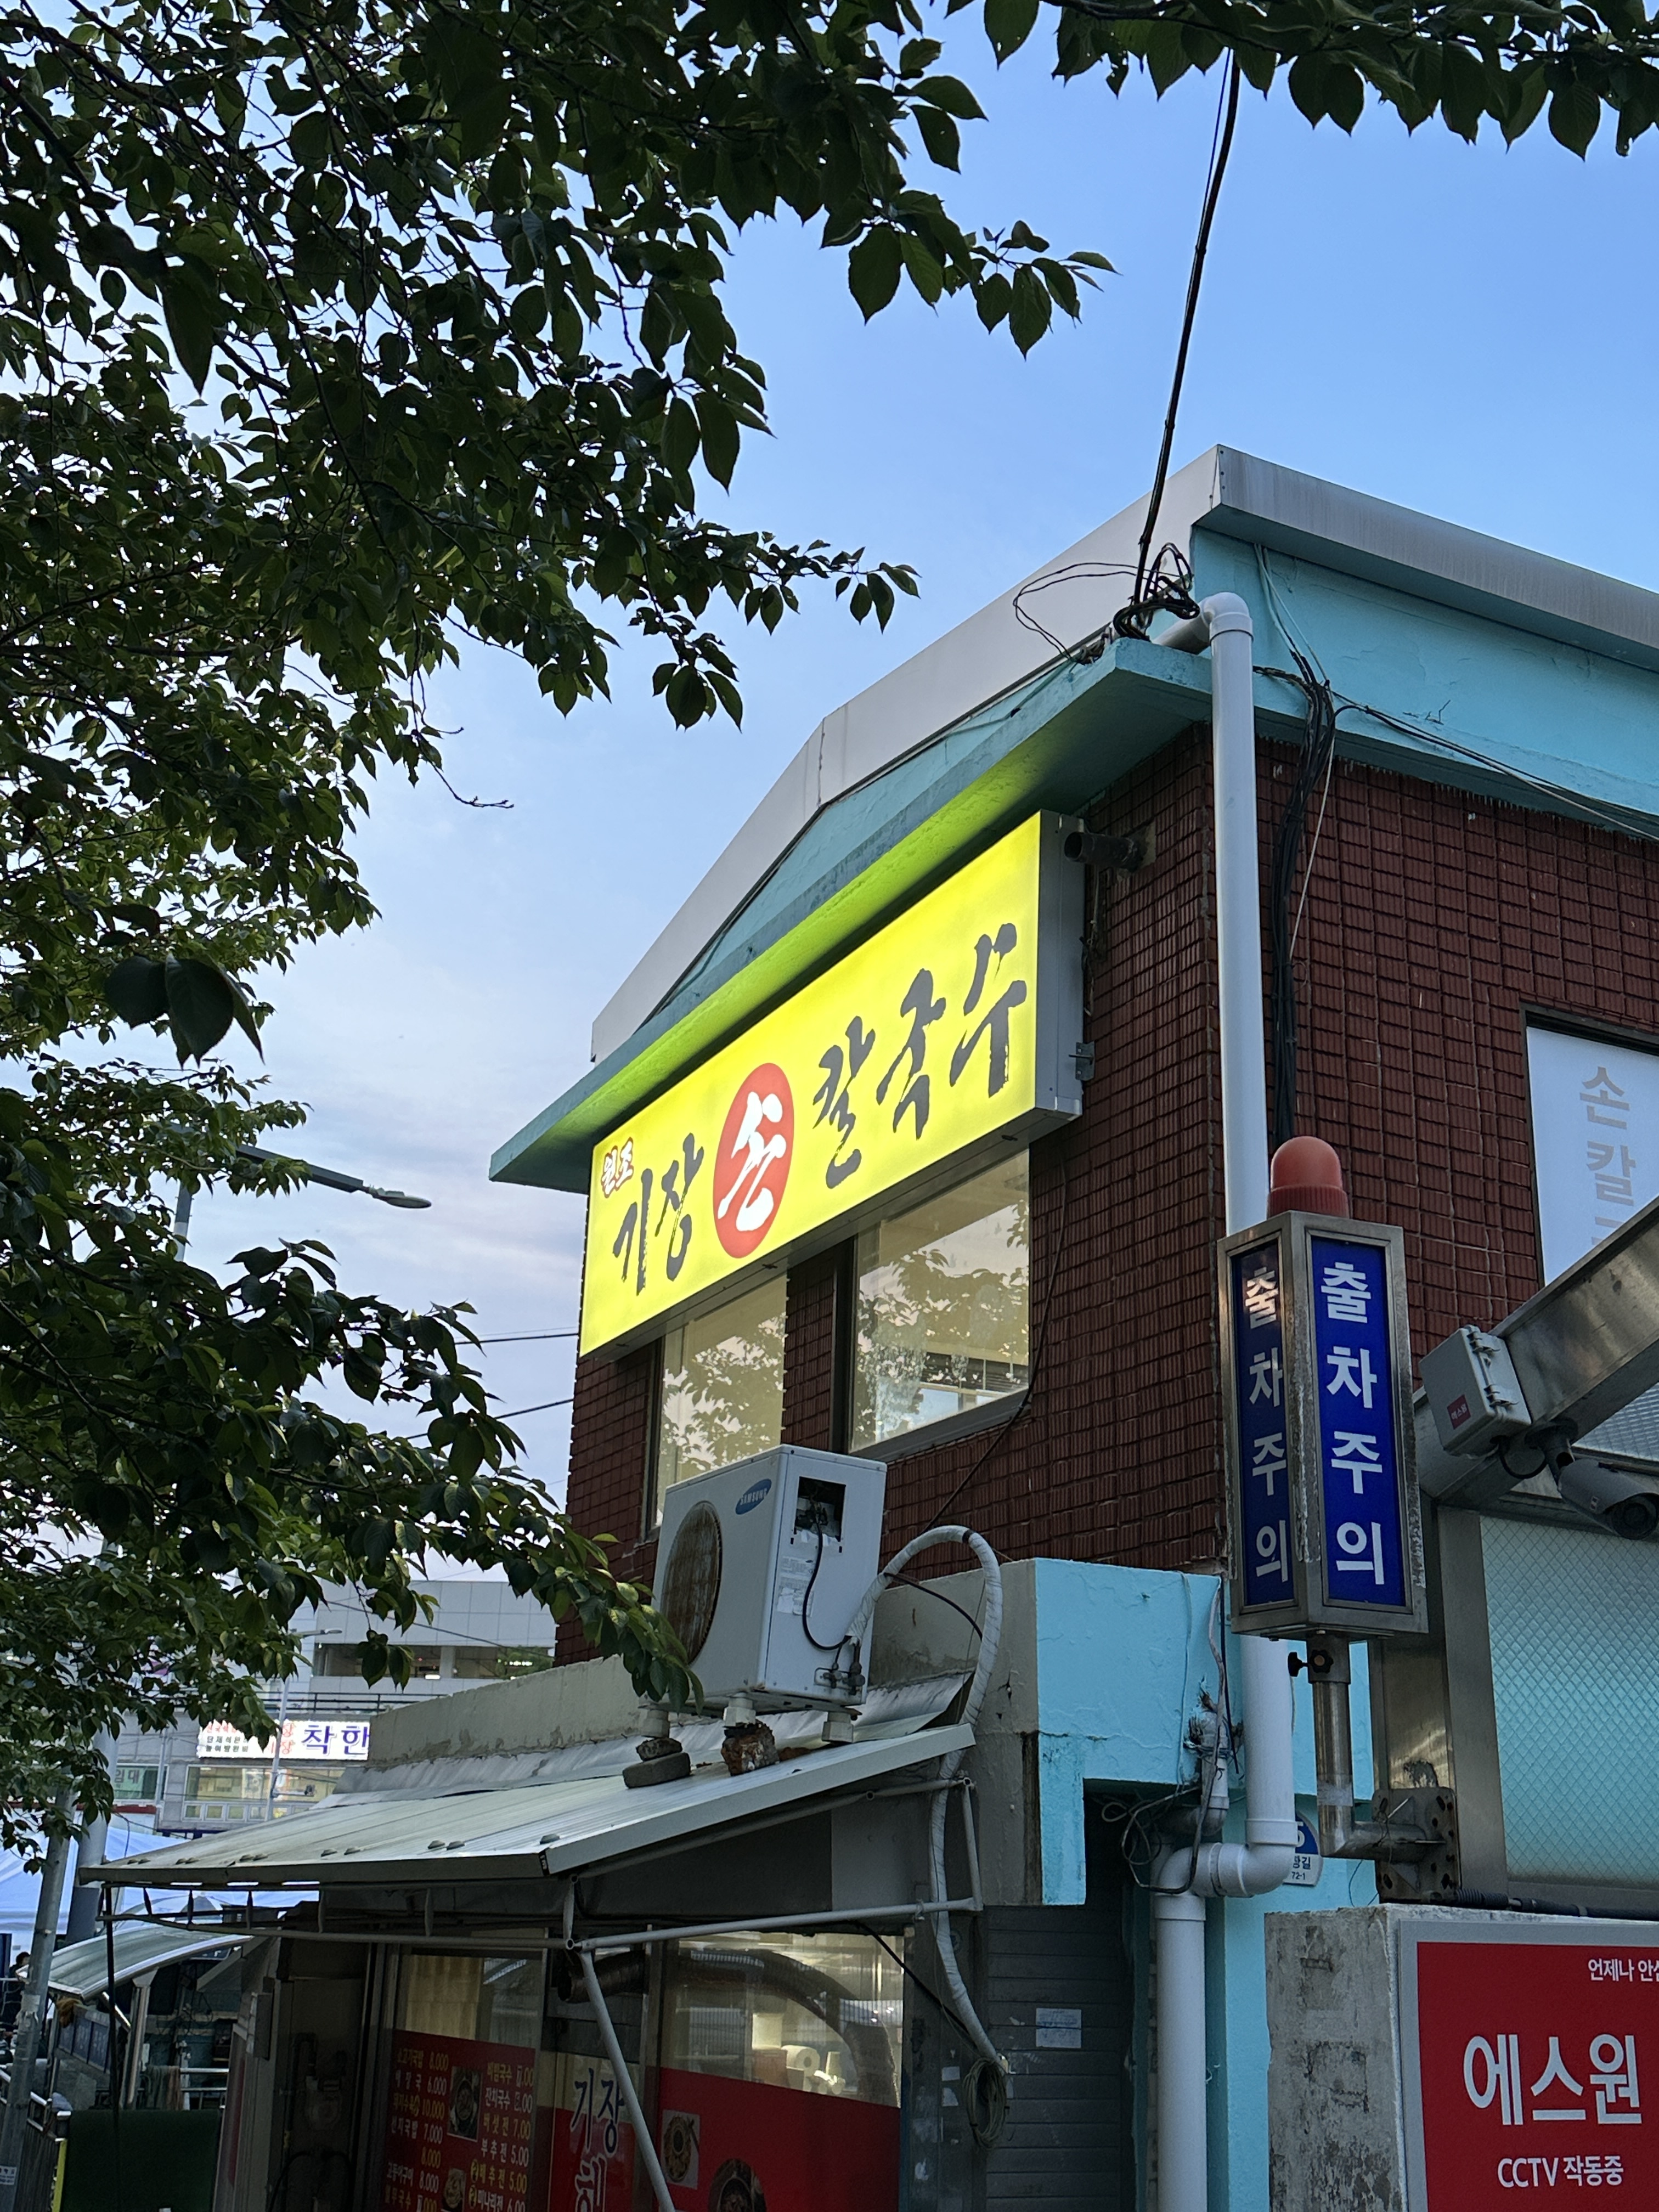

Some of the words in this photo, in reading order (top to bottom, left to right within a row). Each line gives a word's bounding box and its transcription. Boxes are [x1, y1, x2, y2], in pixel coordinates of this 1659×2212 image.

[613, 1133, 704, 1295] 기장
[812, 923, 1027, 1189] 칼국수
[601, 1137, 634, 1198] 원조
[1245, 1267, 1289, 1582] 출차주의
[1321, 1262, 1384, 1585] 출차주의
[740, 1487, 768, 1506] SAMSUNG
[301, 1724, 369, 1755] 착한
[1588, 1957, 1635, 1982] 언제나
[1463, 2033, 1643, 2126] 에스원
[1498, 2157, 1559, 2188] CCTV
[1564, 2154, 1624, 2187] 작동중
